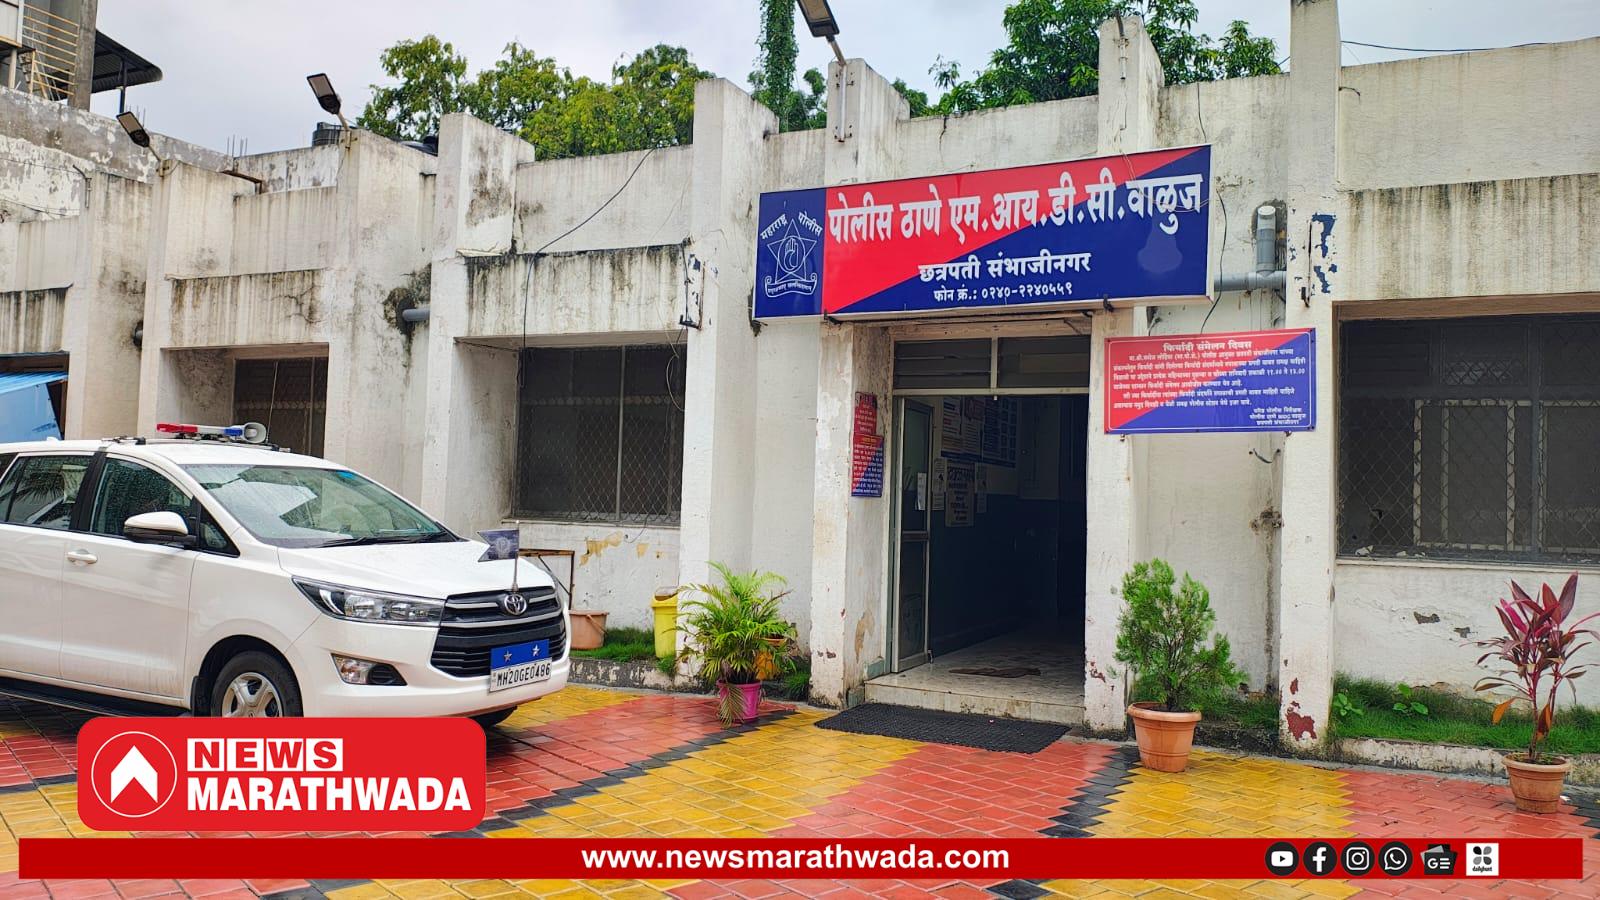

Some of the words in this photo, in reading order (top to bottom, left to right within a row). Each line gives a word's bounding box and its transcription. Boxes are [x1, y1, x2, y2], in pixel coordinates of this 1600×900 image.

[798, 210, 823, 237] पोलीस
[828, 192, 894, 244] पोलीस
[899, 184, 943, 239] ठाणे
[918, 255, 981, 282] छत्रपती
[986, 248, 1092, 278] संभाजीनगर
[933, 285, 954, 302] फोन
[981, 281, 1073, 299] ०२४०-२२४०५५९
[496, 662, 551, 687] MH20GE0486
